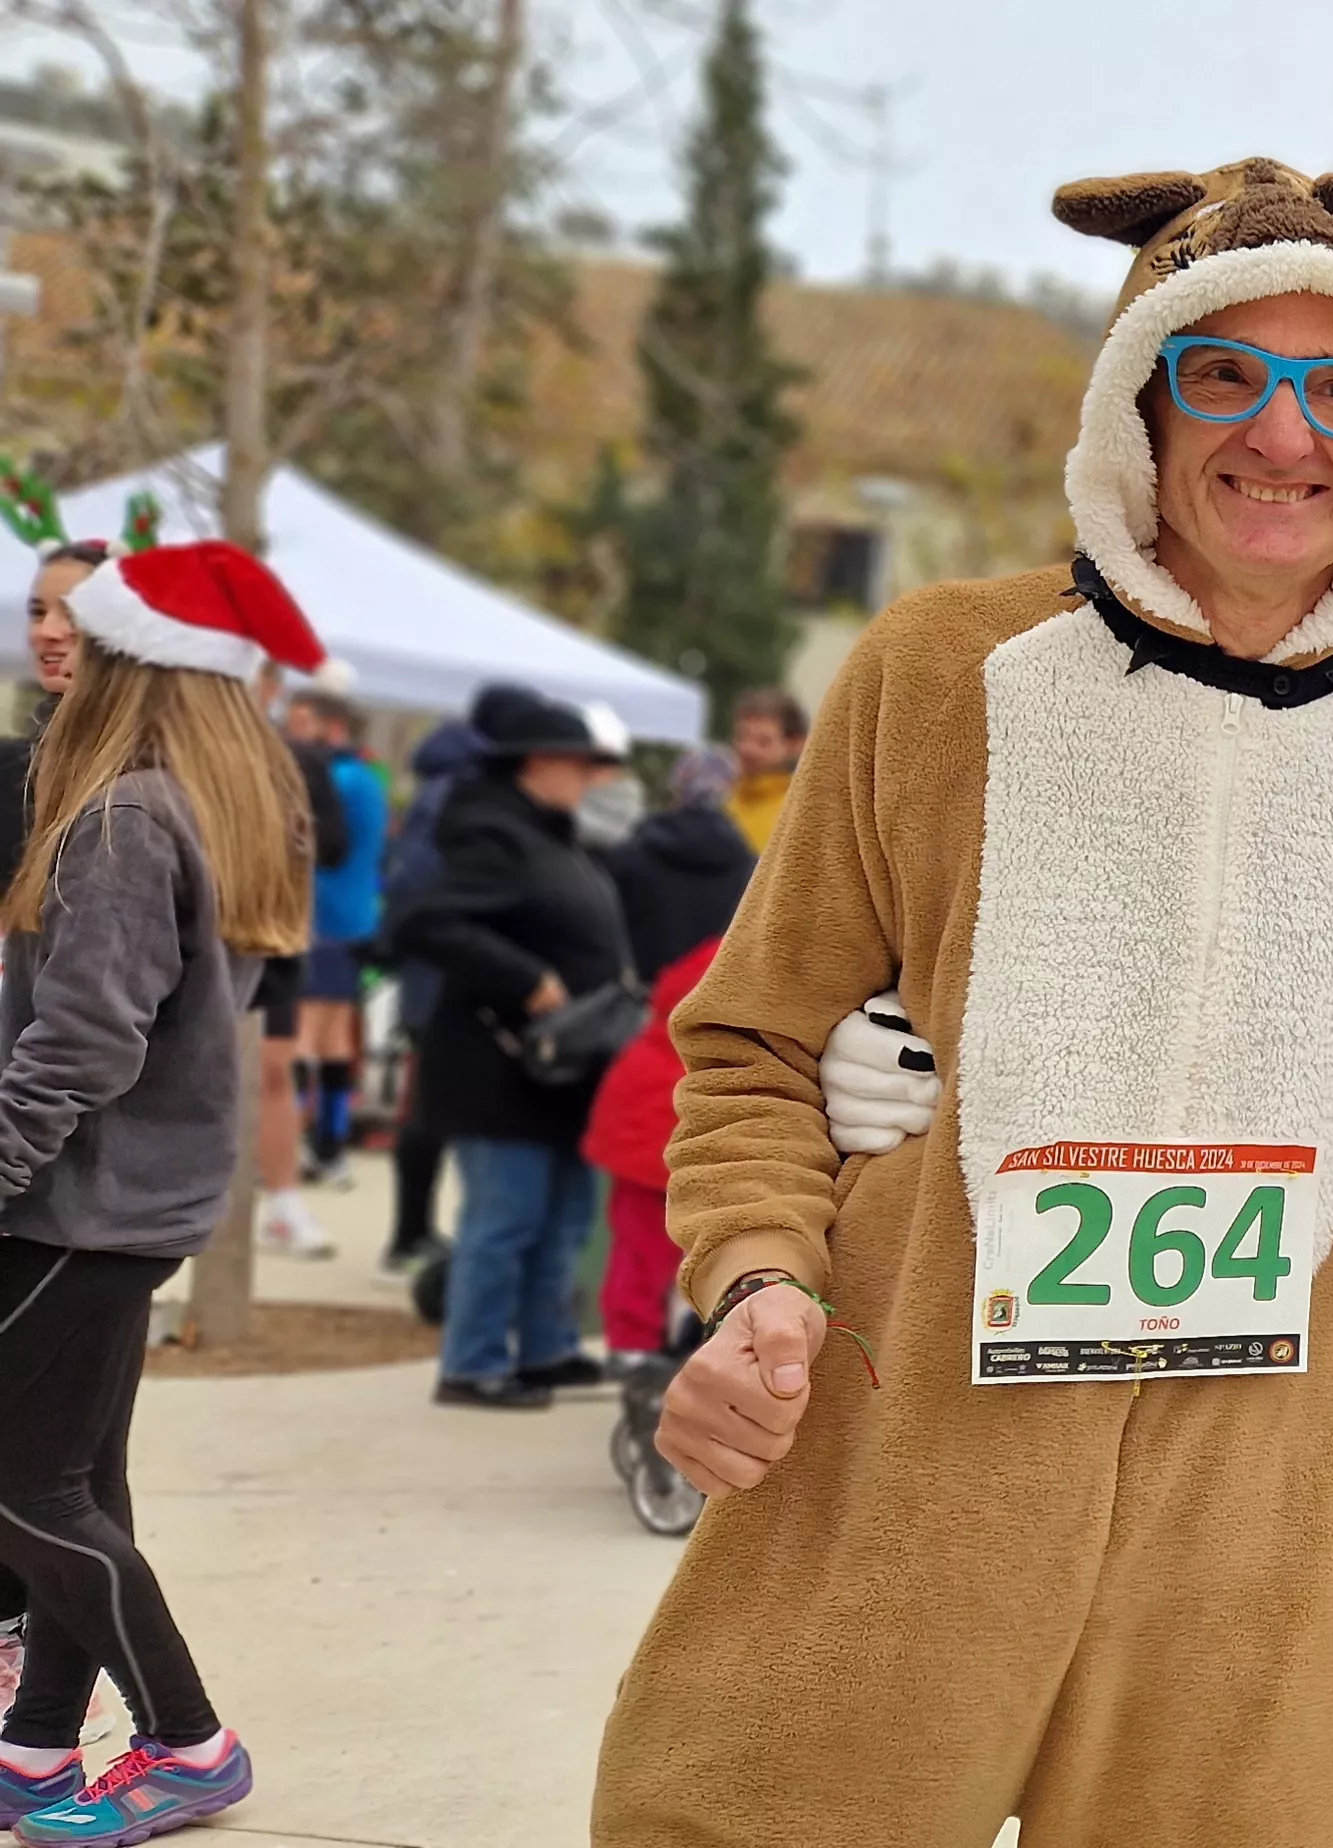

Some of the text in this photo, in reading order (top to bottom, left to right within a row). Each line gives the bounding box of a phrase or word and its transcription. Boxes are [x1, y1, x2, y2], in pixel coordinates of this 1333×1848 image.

[1008, 1146, 1234, 1170] SAN SILVESTRE HUESCA 2024
[1026, 1182, 1291, 1307] 264
[1139, 1316, 1180, 1332] TOÑO
